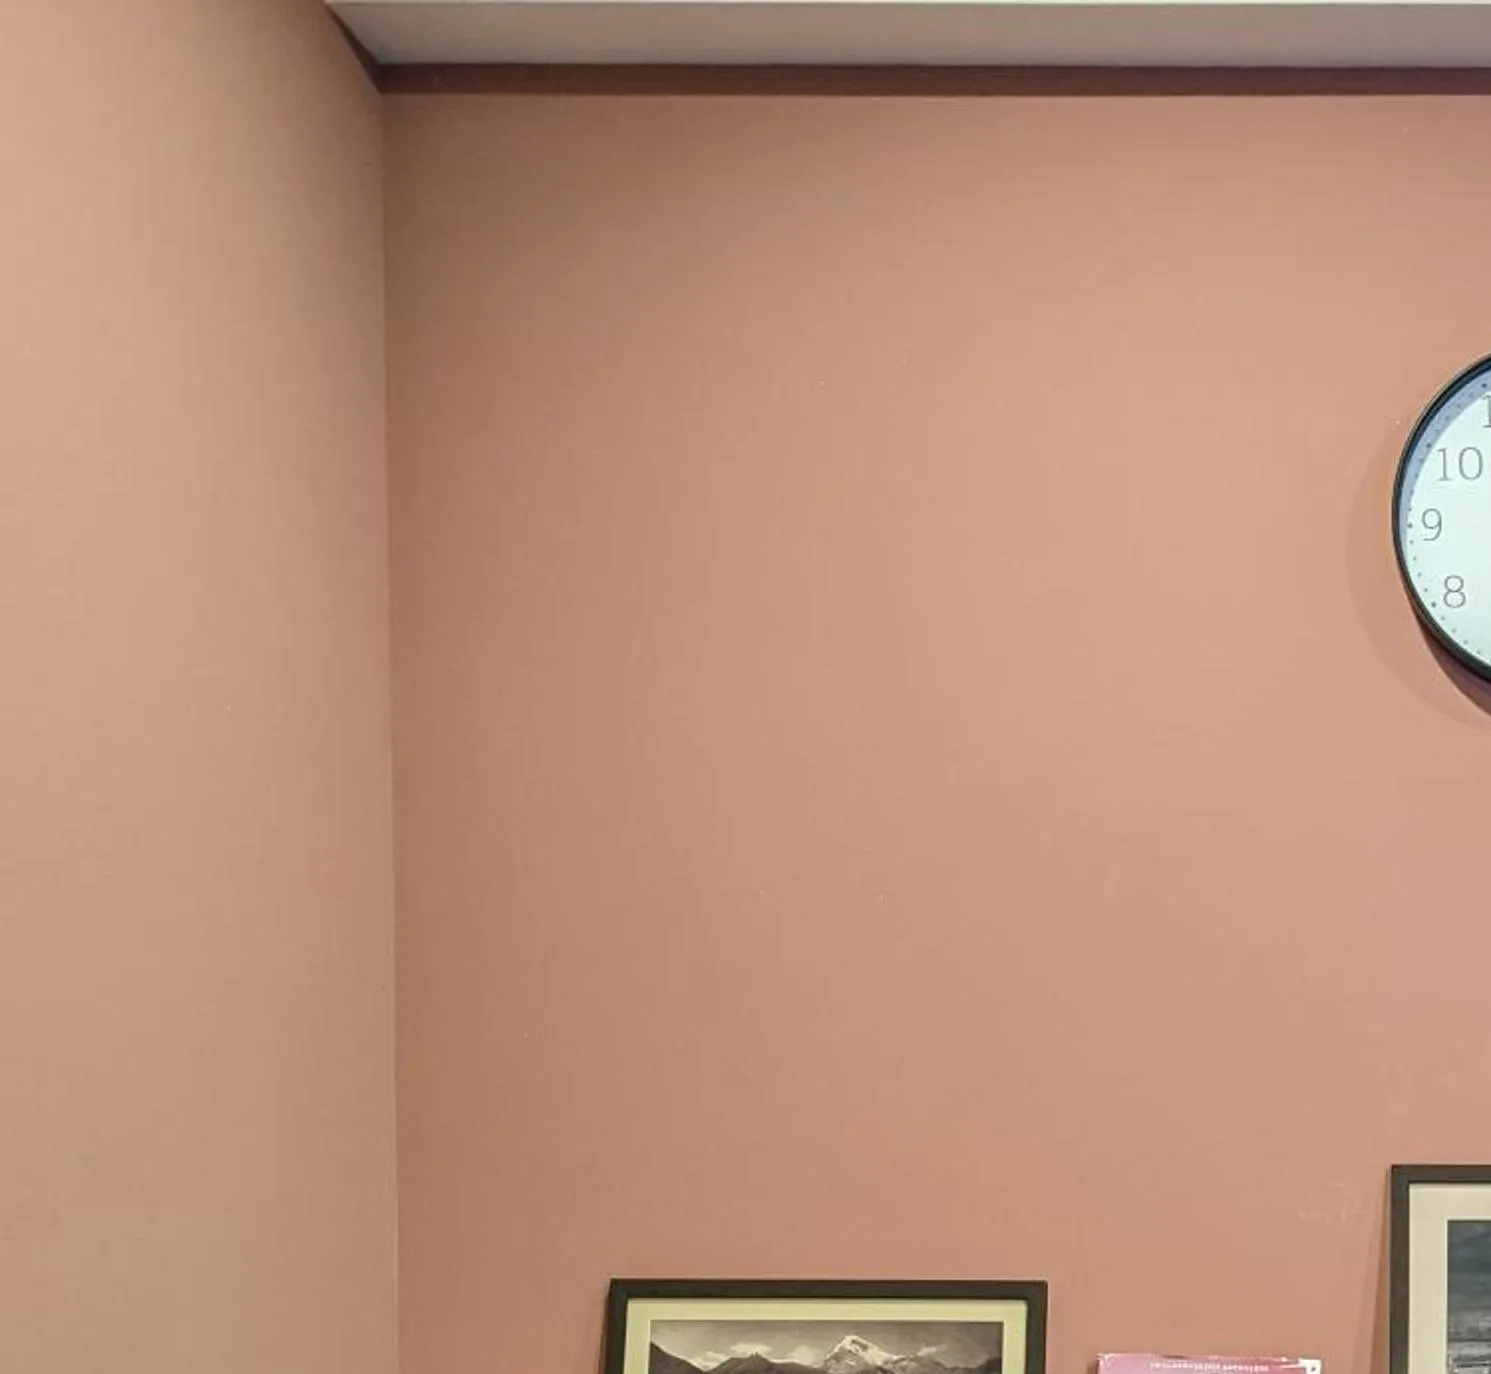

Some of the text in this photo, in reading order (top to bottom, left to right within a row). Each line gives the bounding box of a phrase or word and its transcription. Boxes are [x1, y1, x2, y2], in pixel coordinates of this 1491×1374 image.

[1436, 446, 1484, 482] 10
[1420, 508, 1442, 542] 9
[1442, 574, 1467, 609] 8
